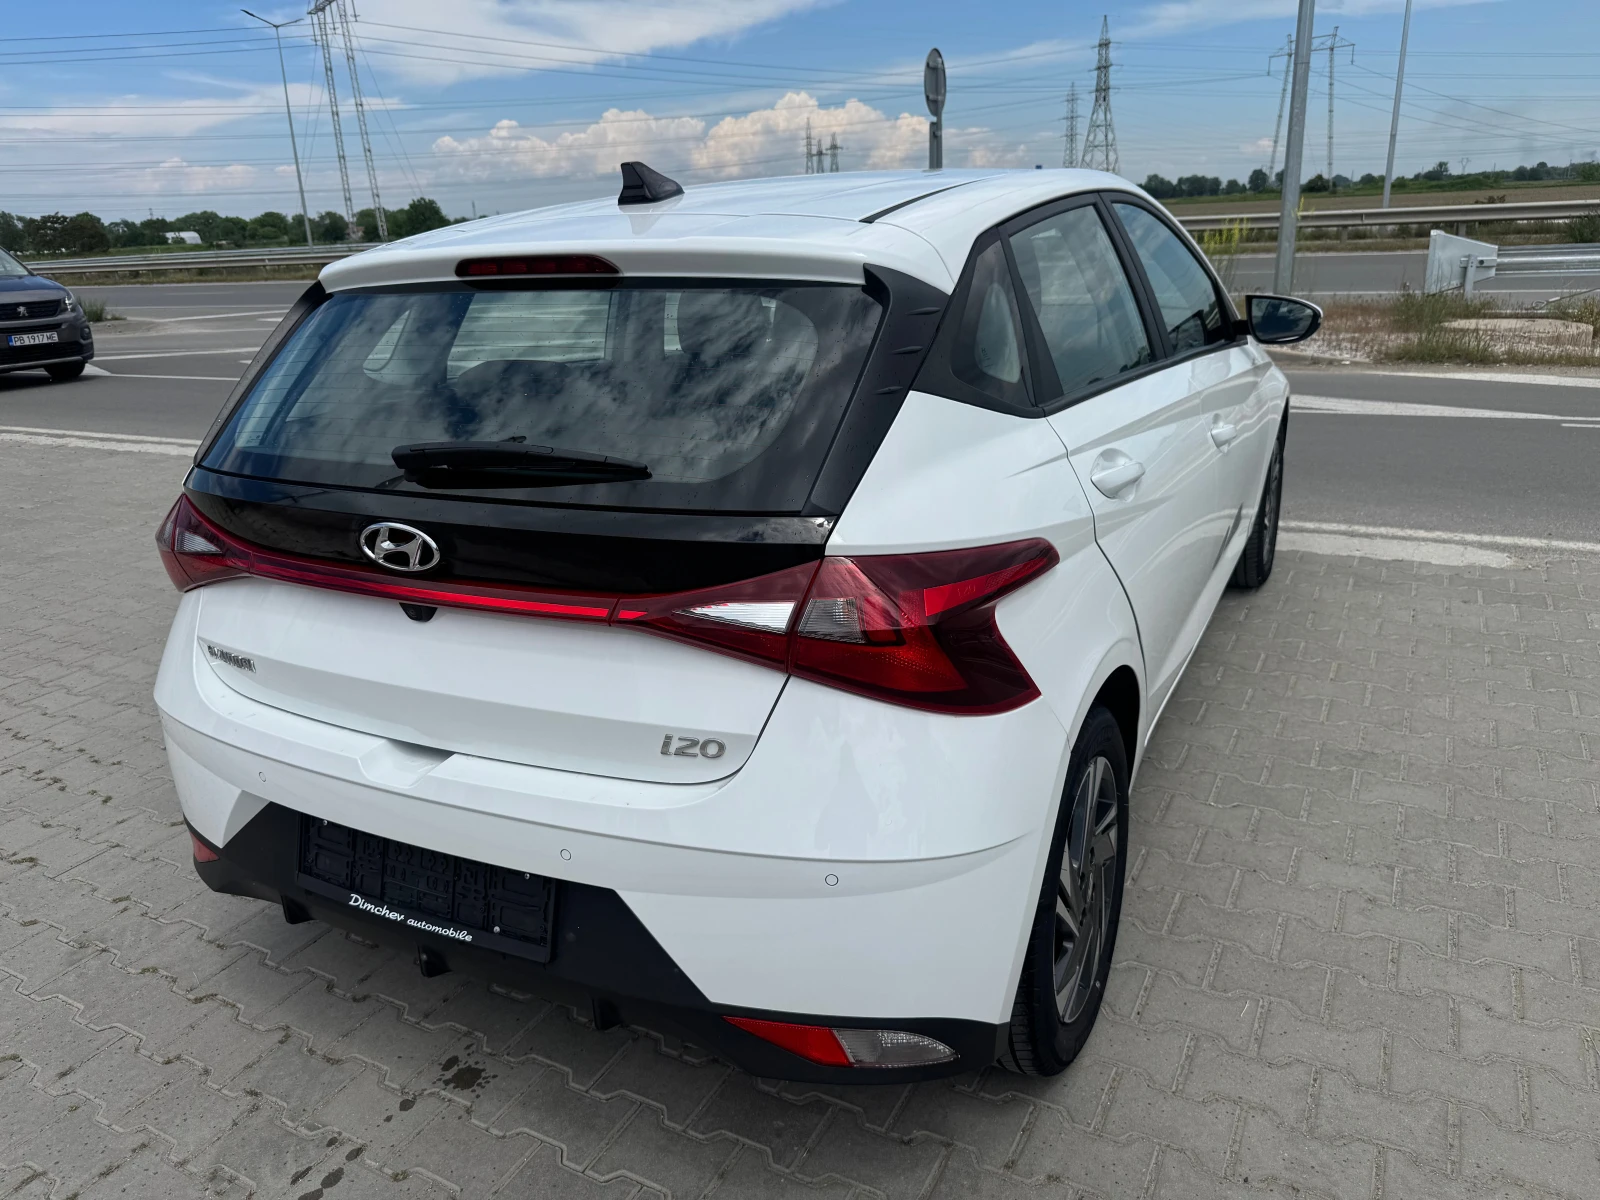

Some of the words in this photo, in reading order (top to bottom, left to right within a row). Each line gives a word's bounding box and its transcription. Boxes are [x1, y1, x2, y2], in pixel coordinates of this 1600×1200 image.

[13, 336, 25, 345] PB
[27, 334, 44, 343] 1917
[660, 733, 727, 759] i20
[348, 893, 405, 922] Dimchev
[406, 918, 473, 942] automobile
